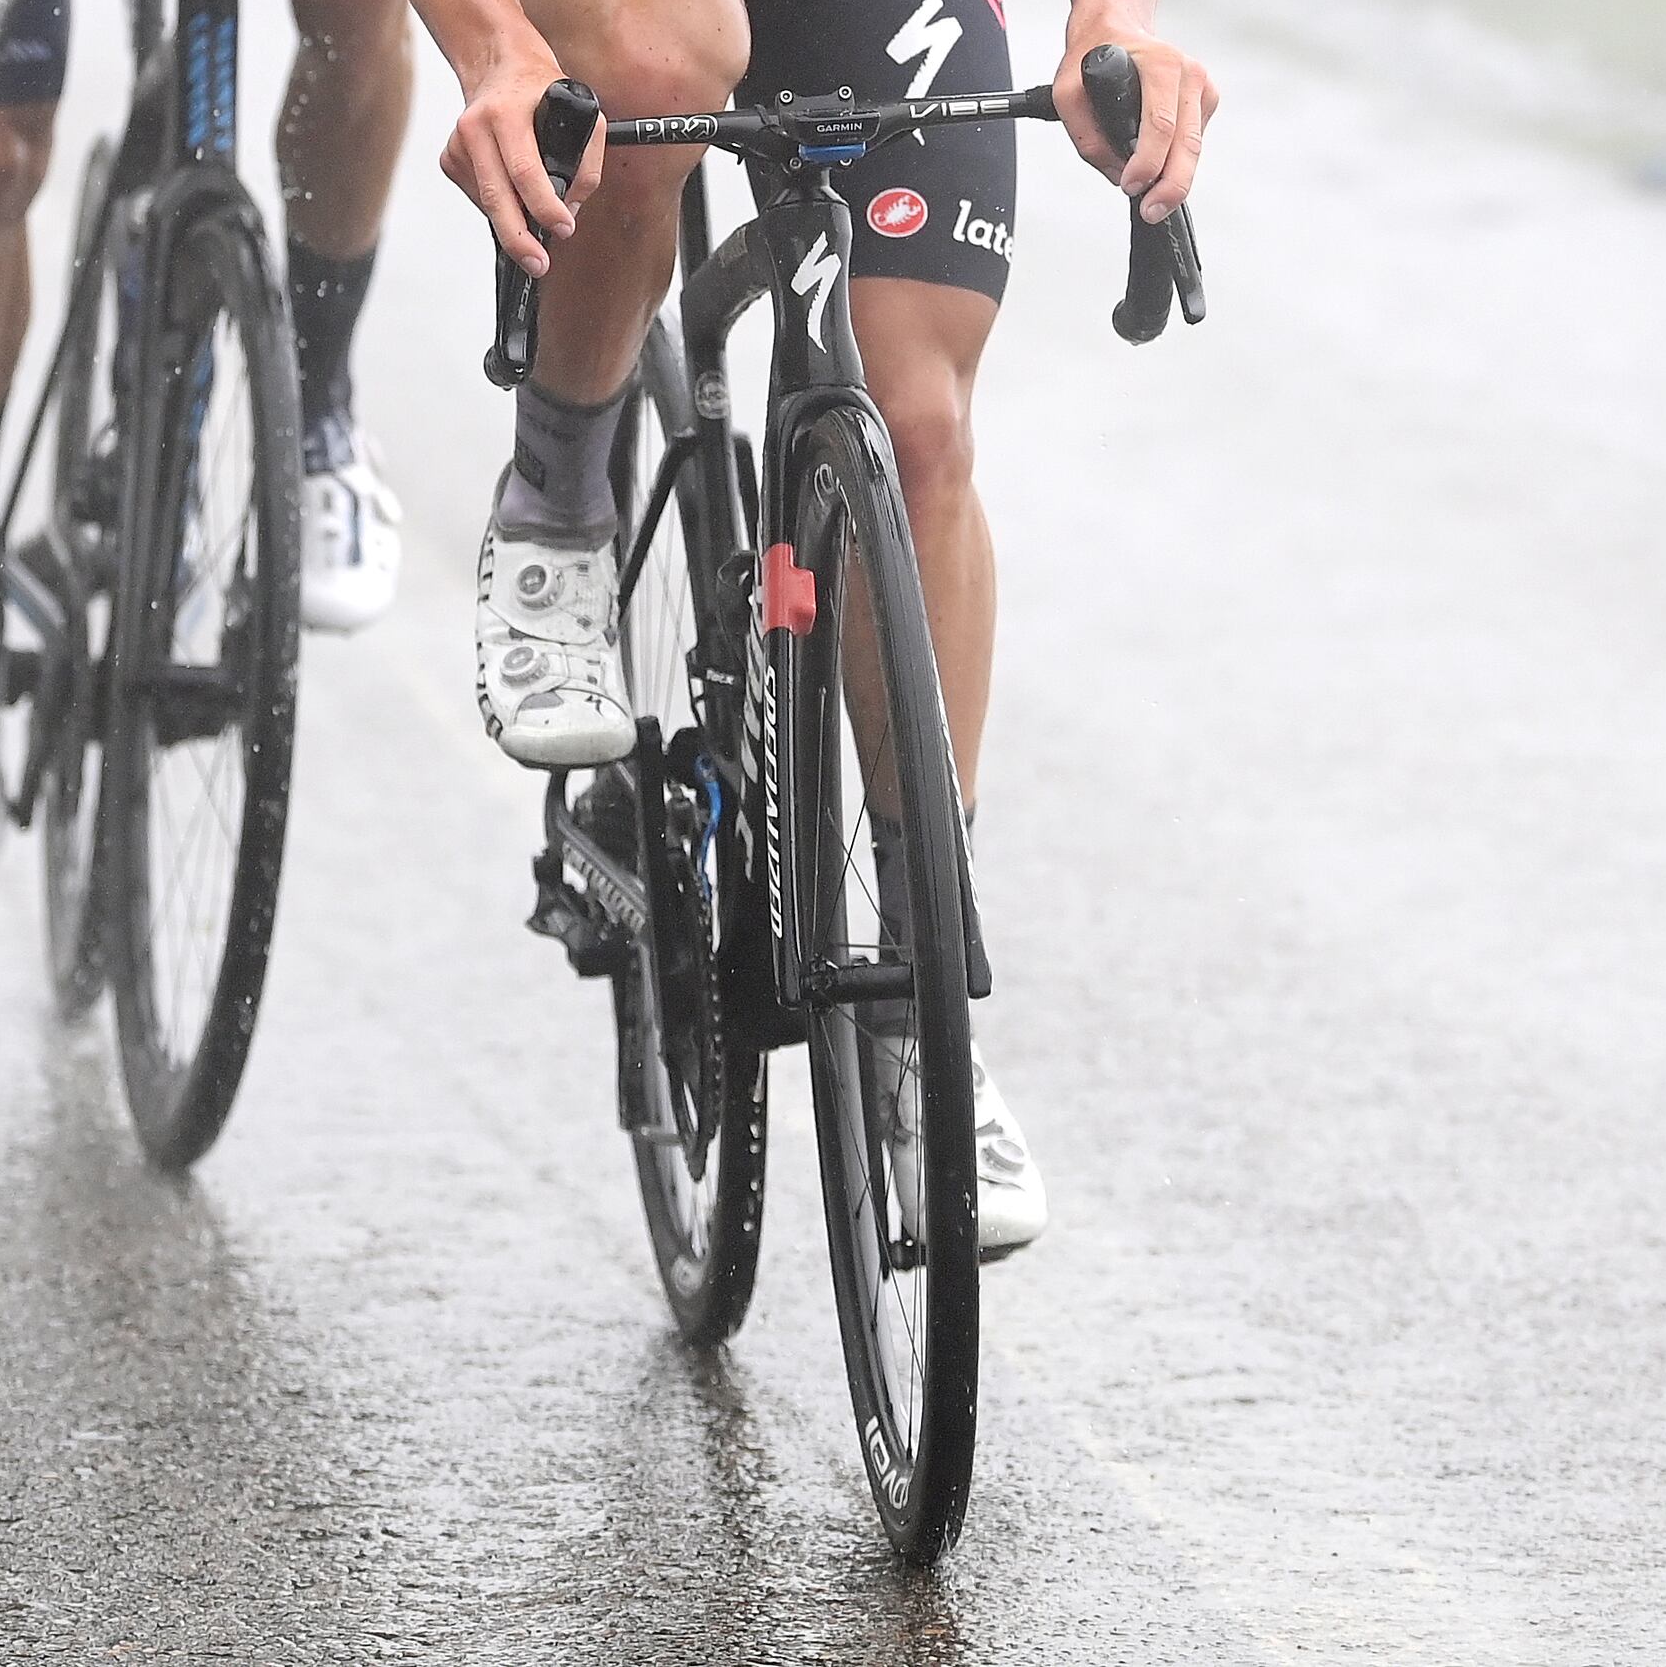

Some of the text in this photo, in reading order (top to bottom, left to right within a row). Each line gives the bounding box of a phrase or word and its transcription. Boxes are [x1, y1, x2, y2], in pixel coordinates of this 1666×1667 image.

[909, 98, 1011, 119] VIBE
[636, 114, 719, 144] PRO
[816, 122, 864, 134] GARMIN
[952, 198, 1013, 264] late
